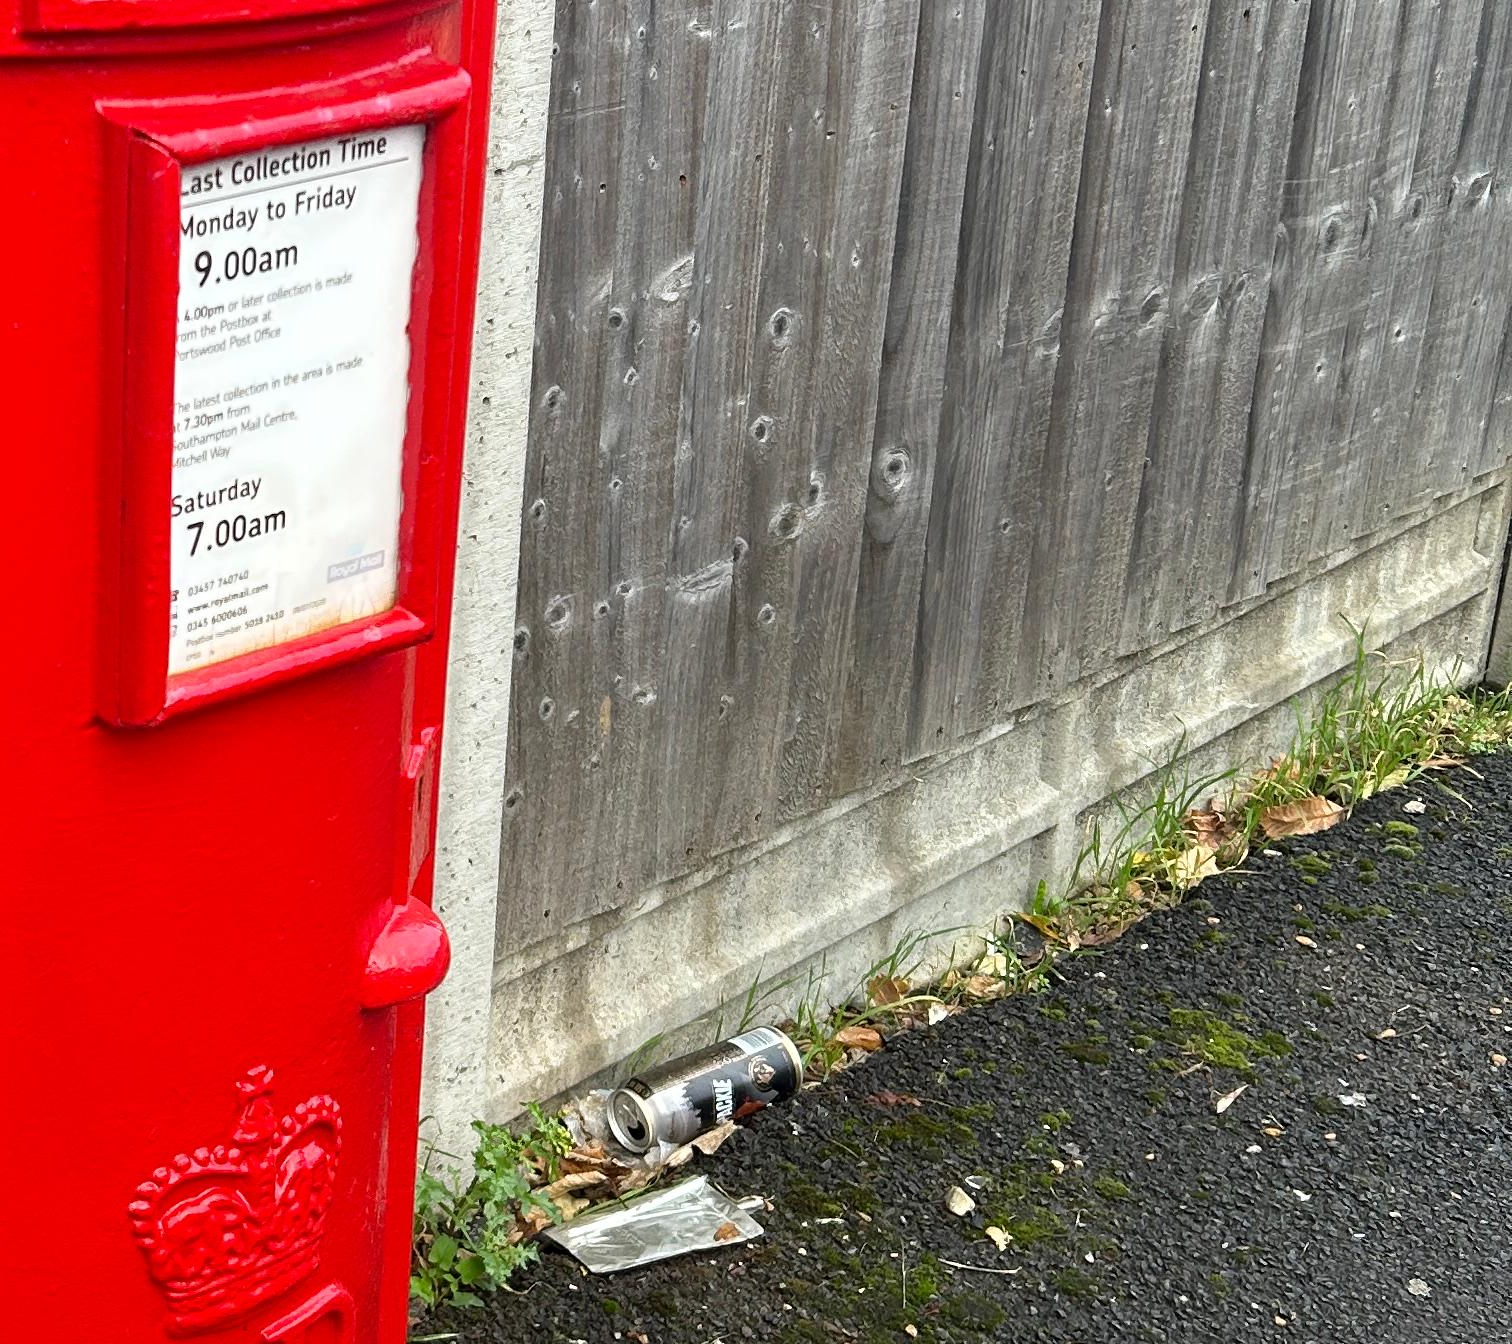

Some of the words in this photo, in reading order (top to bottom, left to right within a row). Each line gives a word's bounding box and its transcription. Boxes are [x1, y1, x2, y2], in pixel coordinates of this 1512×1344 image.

[231, 146, 330, 185] Collection
[339, 136, 387, 163] Time
[267, 201, 286, 221] to
[295, 185, 357, 216] Friday
[194, 244, 298, 288] 9.00am
[184, 303, 225, 323] 4.00pm
[228, 300, 239, 312] or
[241, 294, 264, 310] later
[267, 282, 312, 303] collection
[315, 278, 323, 291] is
[325, 273, 353, 289] made
[177, 328, 197, 344] rom
[200, 321, 217, 338] the
[220, 312, 259, 333] Postbox
[262, 309, 272, 324] at
[229, 332, 251, 348] Post
[254, 326, 281, 344] Office
[175, 400, 190, 415] he
[193, 393, 221, 410] latest
[223, 380, 268, 402] collection
[271, 376, 281, 390] in
[283, 371, 299, 386] the
[301, 367, 323, 382] area
[325, 361, 334, 375] is
[336, 355, 363, 372] made
[184, 411, 223, 430] 7.30pm
[227, 404, 250, 419] from
[241, 417, 261, 433] Mail
[210, 445, 231, 460] Way
[171, 477, 261, 517] Saturday
[187, 510, 286, 557] 7.00am
